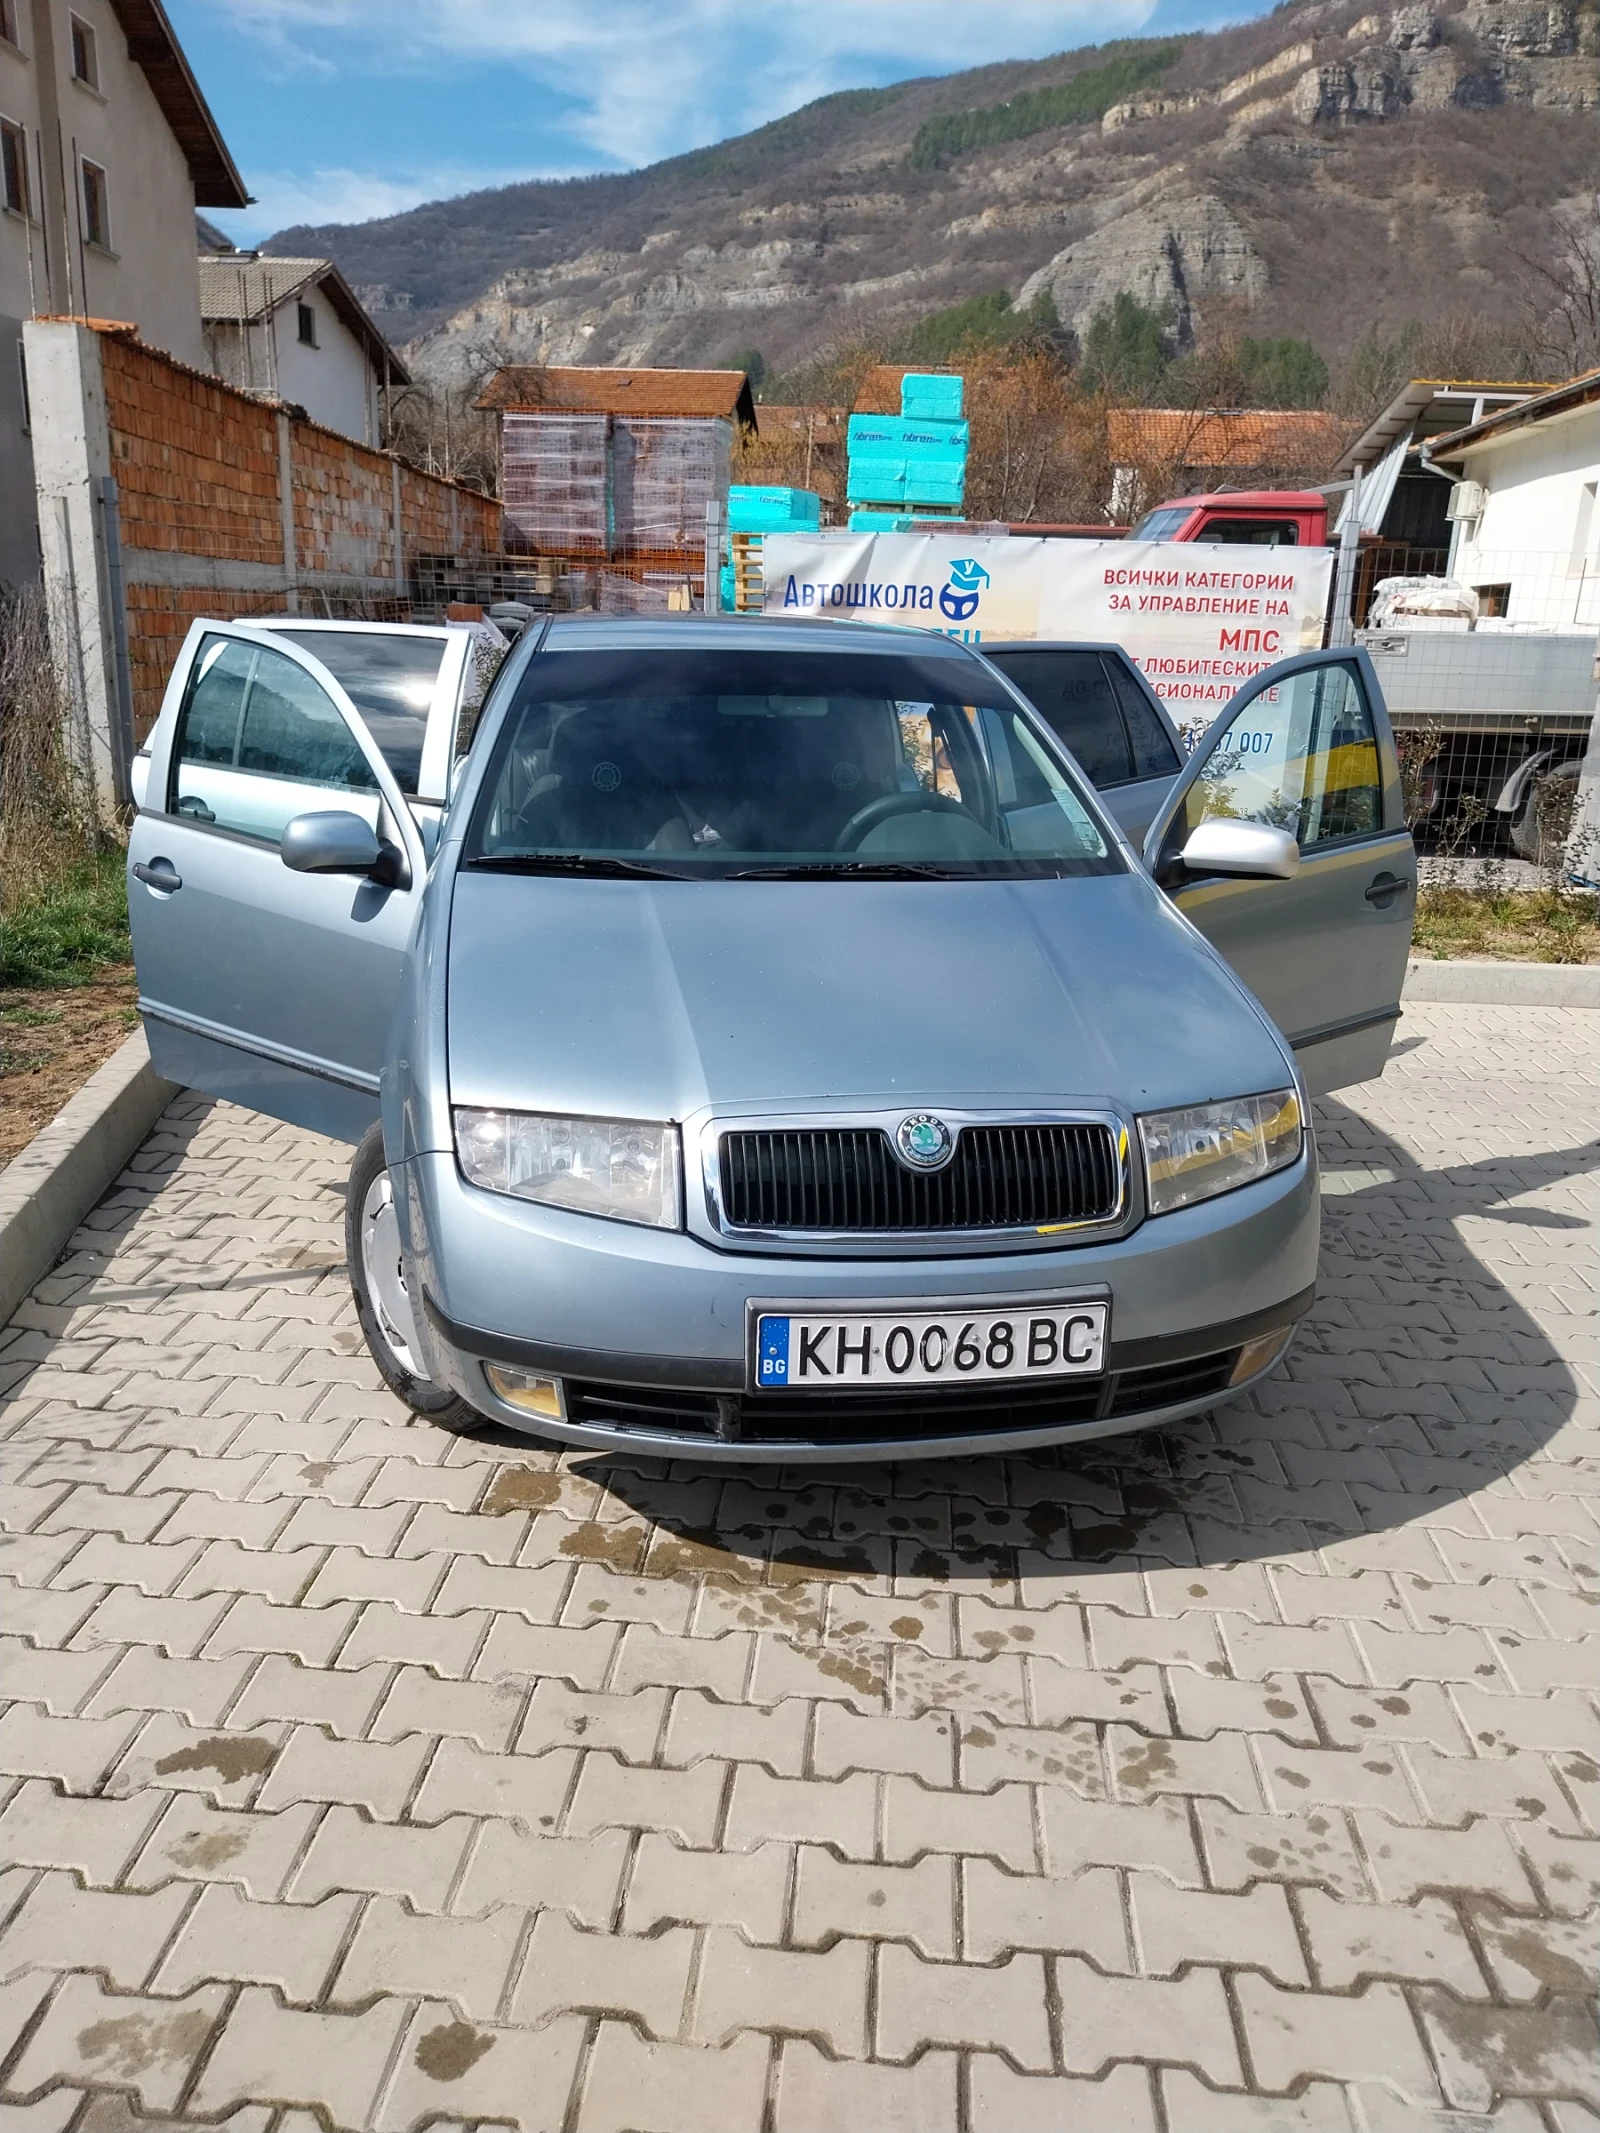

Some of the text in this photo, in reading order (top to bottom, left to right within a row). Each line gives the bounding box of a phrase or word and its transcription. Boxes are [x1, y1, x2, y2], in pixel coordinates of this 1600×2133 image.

[1104, 569, 1294, 591] ВСИЧКИ КАТЕГОРИИ
[784, 574, 934, 610] Автошкола
[1108, 594, 1290, 616] ЗА УПРАВЛЕНИЕ НА
[1219, 628, 1284, 655] МПС,
[1144, 657, 1277, 677] ЛЮБИТЕСКИТ
[1240, 732, 1274, 754] 007
[763, 1359, 787, 1376] BG
